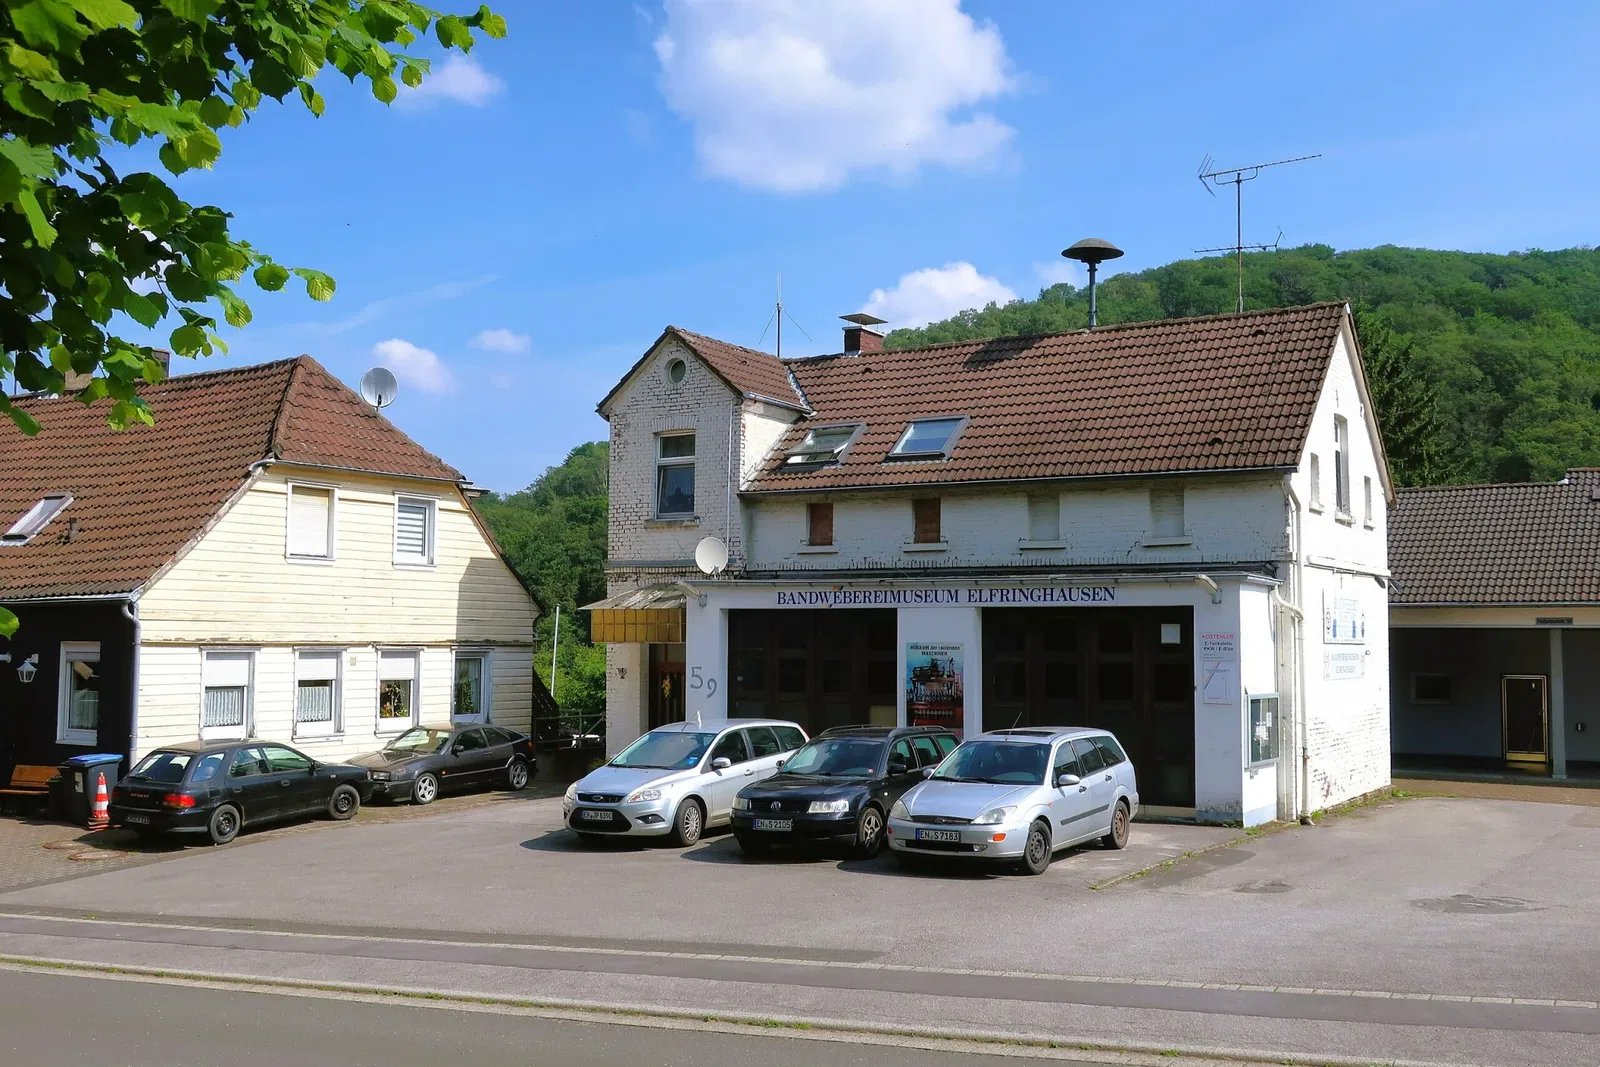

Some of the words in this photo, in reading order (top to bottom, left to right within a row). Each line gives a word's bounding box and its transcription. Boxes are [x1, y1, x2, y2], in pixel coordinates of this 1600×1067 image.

[777, 589, 959, 605] BANDWEBEREIMUSEUM
[967, 586, 1117, 603] ELFRINGHAUSEN
[690, 666, 718, 699] 59
[920, 830, 930, 839] EN
